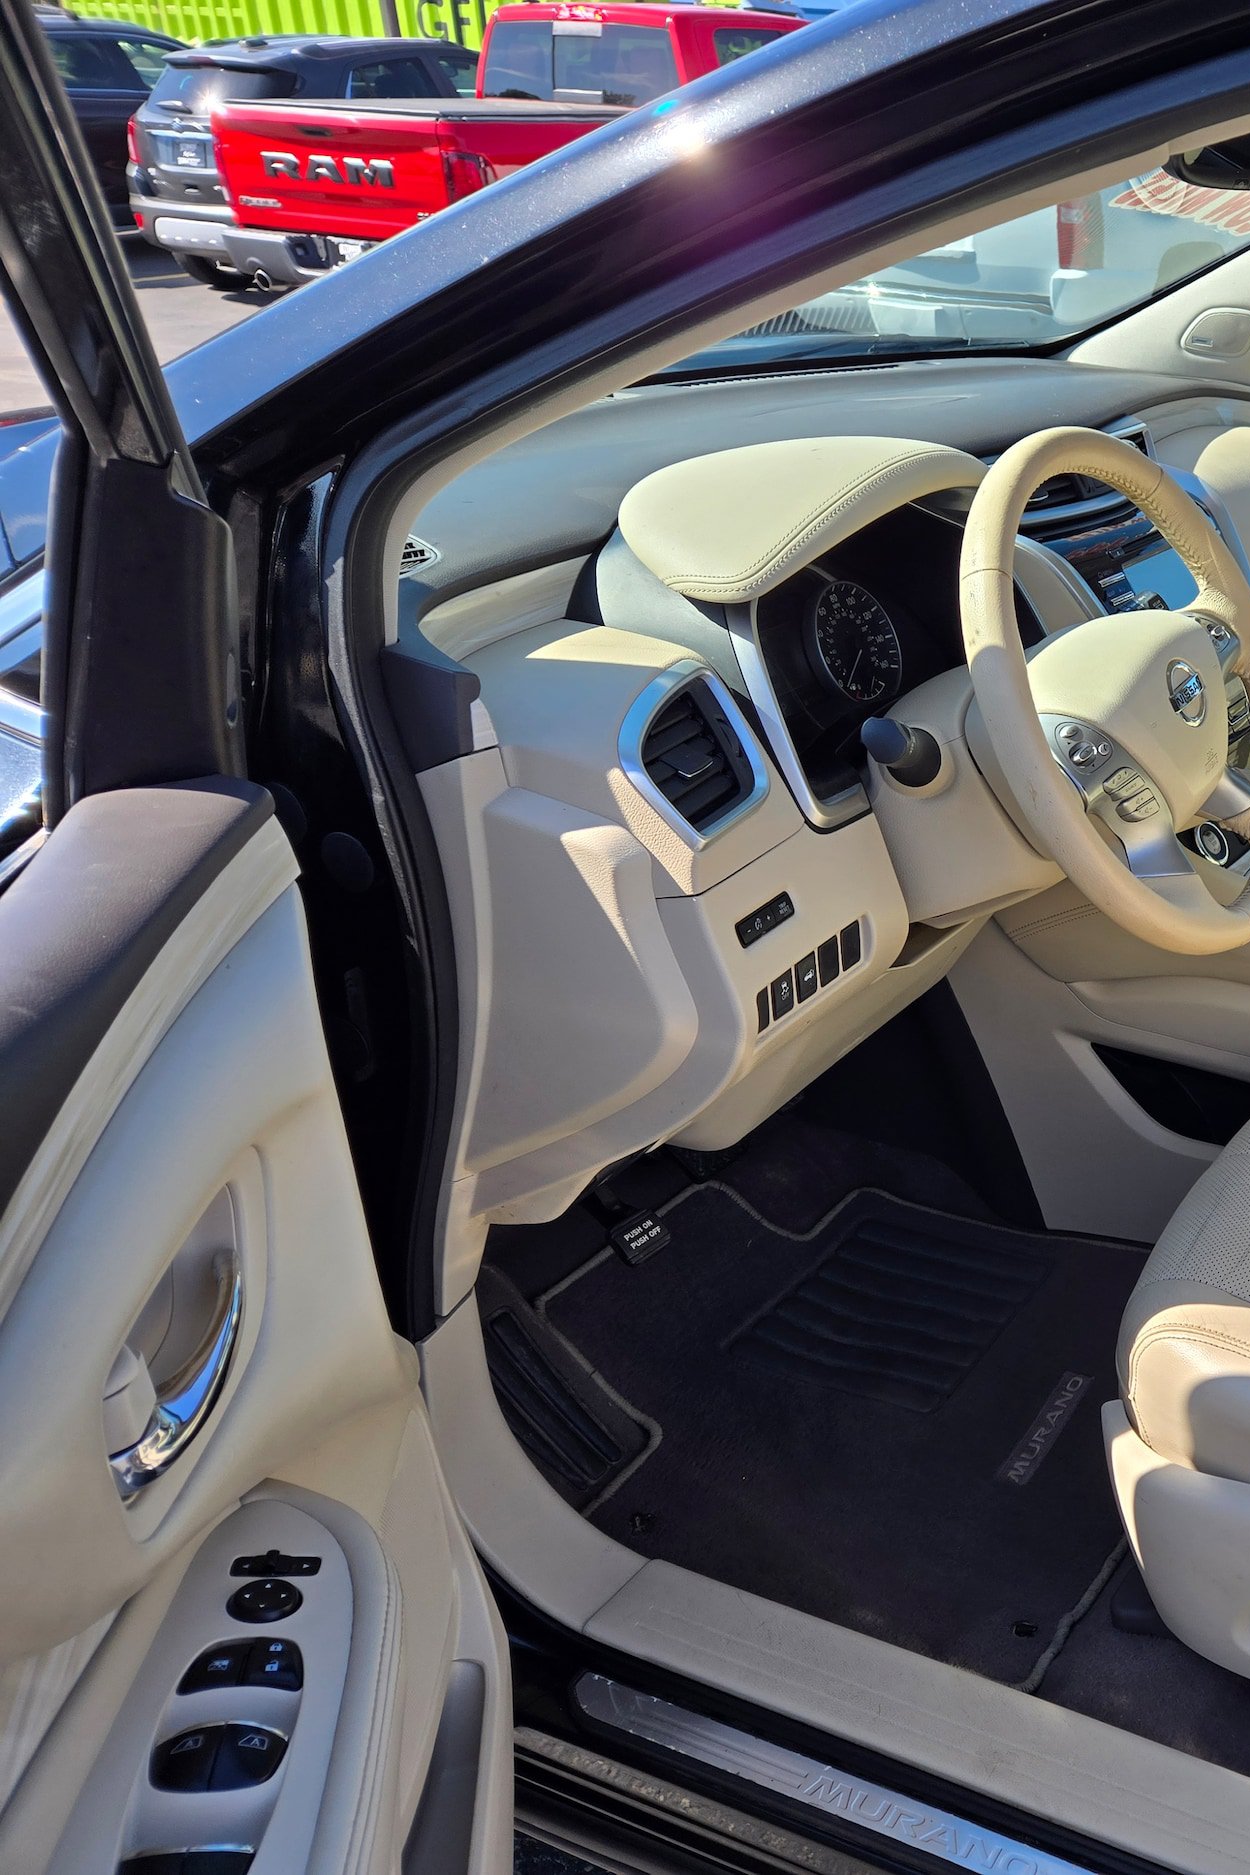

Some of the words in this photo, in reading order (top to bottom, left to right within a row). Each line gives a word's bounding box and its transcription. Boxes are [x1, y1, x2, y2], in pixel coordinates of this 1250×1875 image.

[260, 151, 396, 188] RAM
[623, 1226, 643, 1241] PUSH
[642, 1219, 653, 1229] ON
[630, 1234, 649, 1250] PUSH
[648, 1225, 661, 1237] OFF
[1007, 1376, 1083, 1483] MURANO
[803, 1775, 1038, 1875] MURANO
